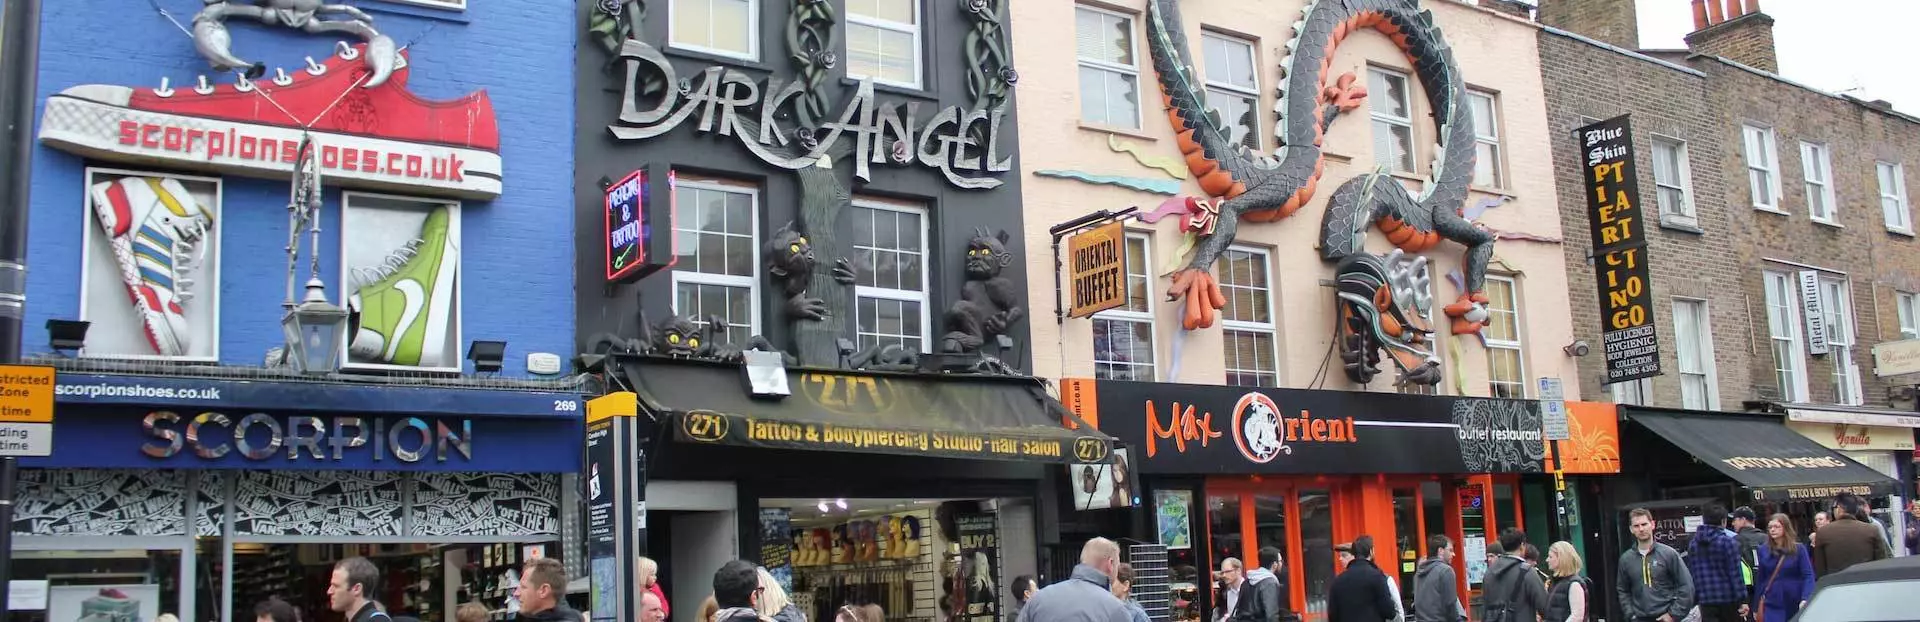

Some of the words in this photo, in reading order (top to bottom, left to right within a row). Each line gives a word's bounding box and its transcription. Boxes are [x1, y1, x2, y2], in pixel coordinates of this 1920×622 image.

[1585, 126, 1623, 147] Blue
[1588, 143, 1627, 167] Skin
[621, 203, 632, 222] &
[611, 219, 640, 249] TATTOO
[1075, 237, 1118, 274] ORIENTAL
[1075, 266, 1118, 309] BUFFET
[1604, 330, 1623, 344] FULLY
[1623, 325, 1654, 340] LICENCED
[1607, 335, 1655, 353] HYGIENIC
[1607, 350, 1623, 361] BODY
[1623, 344, 1657, 360] JEWELLERY
[1615, 355, 1653, 369] COLLECTION
[1610, 370, 1623, 378] 020
[55, 382, 221, 400] scorpionshoes.co.uk
[2, 405, 32, 416] time
[554, 400, 577, 411] 269
[690, 414, 721, 436] 271
[747, 418, 801, 440] Tattoo
[805, 426, 819, 442] &
[1146, 399, 1223, 458] Max
[1459, 426, 1489, 440] buffet
[1491, 427, 1541, 441] restaurant
[141, 411, 472, 463] SCORPION
[1079, 440, 1101, 460] 271
[1722, 456, 1782, 470] TATTOO
[272, 474, 294, 495] THE
[486, 476, 515, 490] VANS
[1788, 488, 1810, 499] TATTOO
[1815, 486, 1829, 497] BODY
[1852, 484, 1871, 496] STUDIO
[345, 490, 371, 507] THE
[520, 499, 551, 517] VANS
[250, 519, 285, 536] VANS
[521, 511, 544, 532] THE
